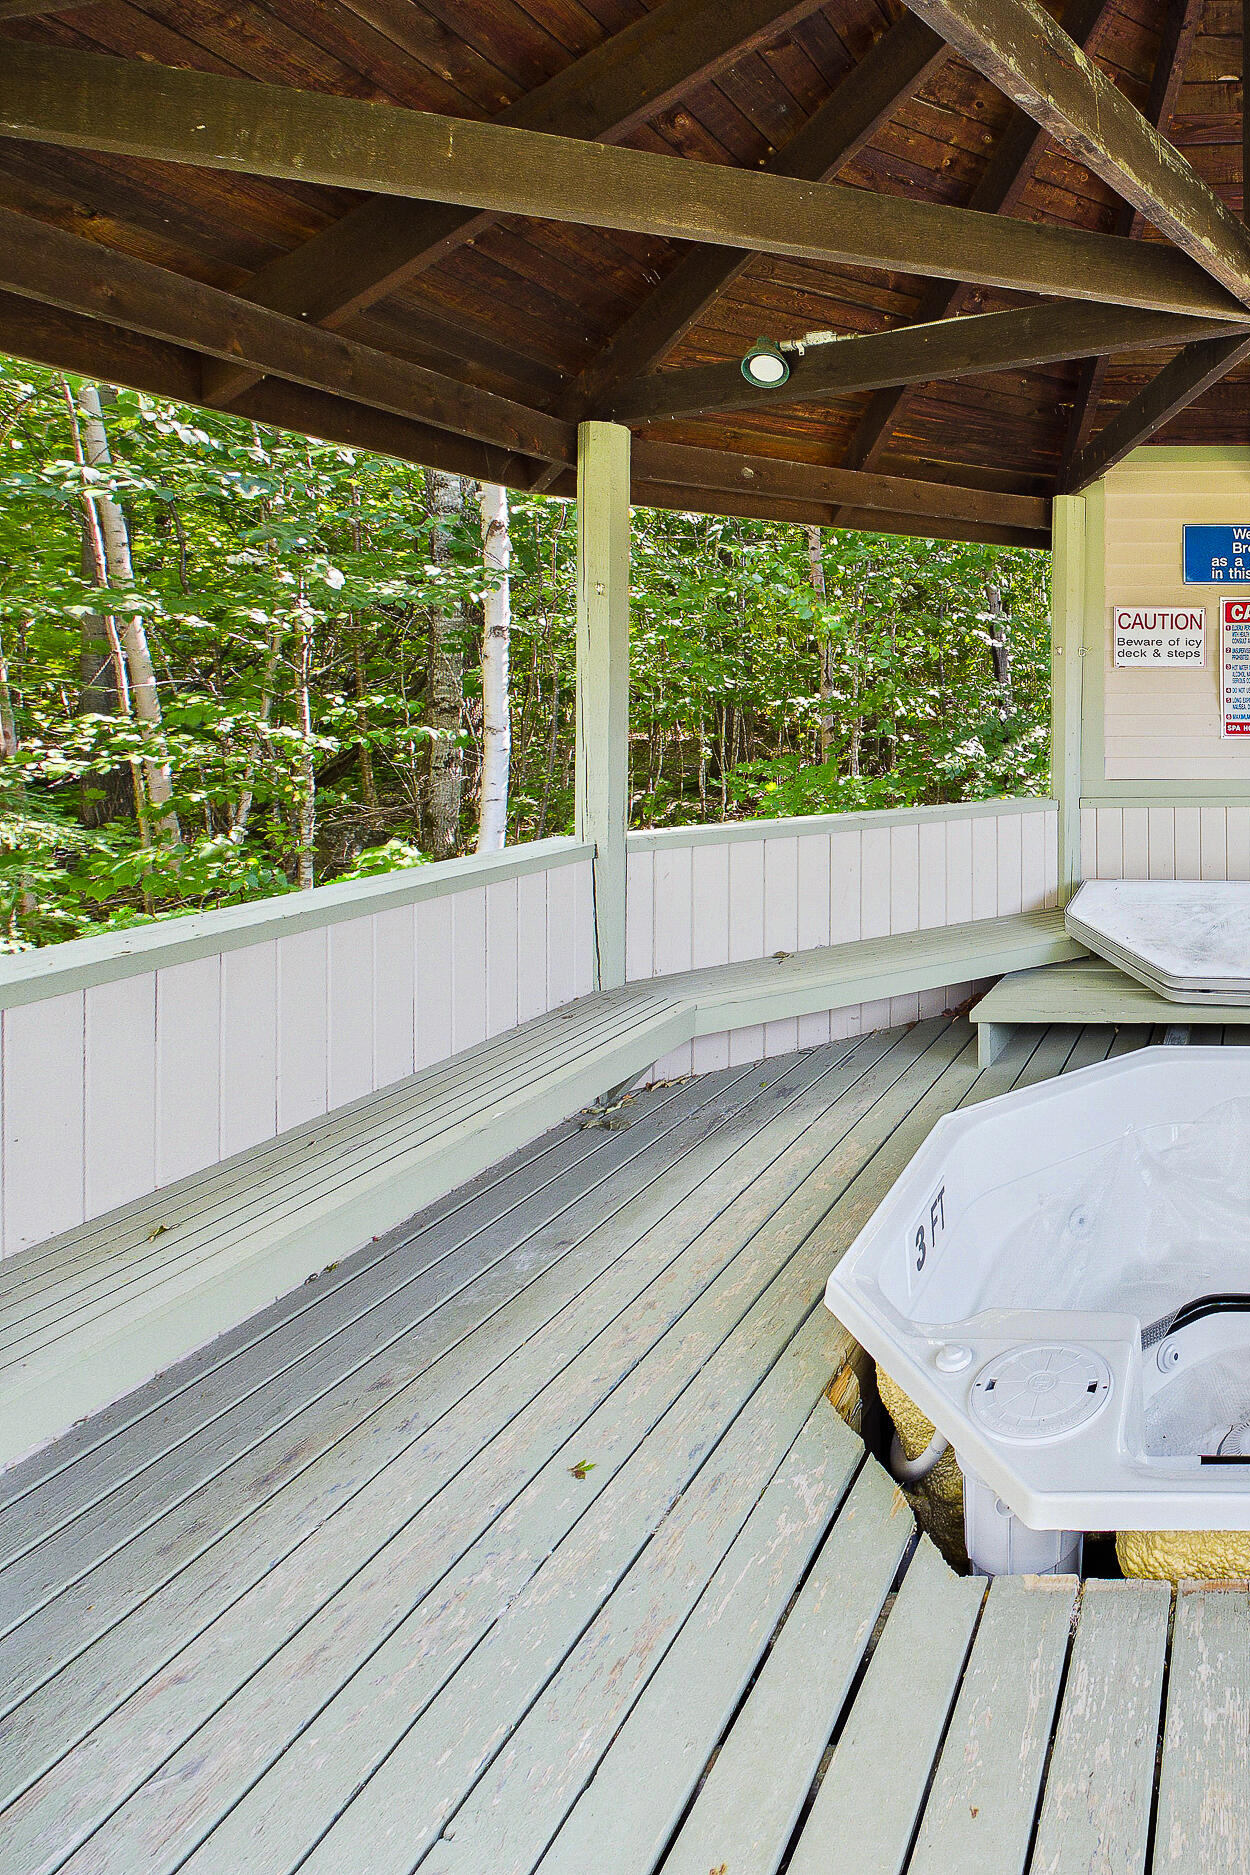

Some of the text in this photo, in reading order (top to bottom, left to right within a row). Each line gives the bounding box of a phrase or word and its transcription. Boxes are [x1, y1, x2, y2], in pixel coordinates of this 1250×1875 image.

[1212, 558, 1227, 566] as
[1235, 558, 1243, 566] a
[1212, 568, 1223, 579] in
[1118, 613, 1202, 630] CAUTION
[1118, 638, 1202, 648] Beware of icy
[1118, 649, 1200, 659] deck & steps
[916, 1186, 945, 1271] 3 FT
